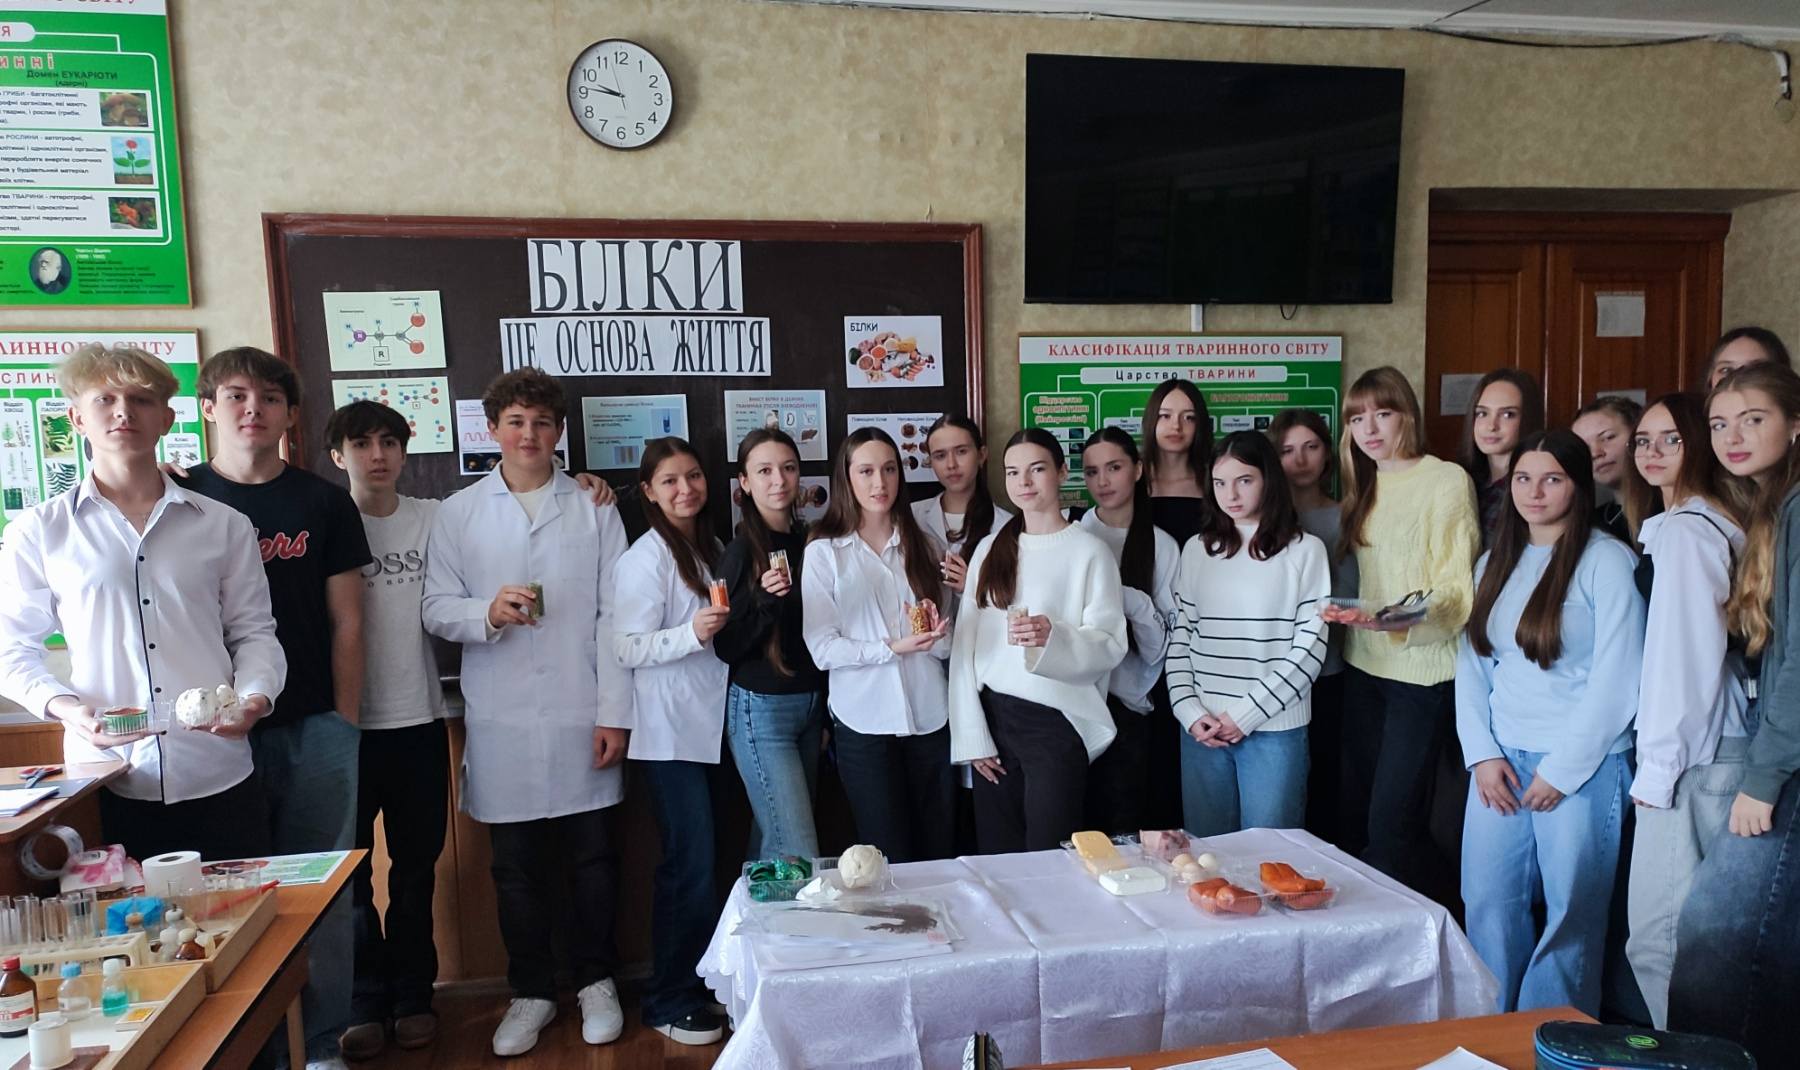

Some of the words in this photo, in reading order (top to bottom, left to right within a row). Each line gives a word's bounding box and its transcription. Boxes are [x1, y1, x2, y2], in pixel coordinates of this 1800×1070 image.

[596, 55, 608, 70] 11
[614, 51, 629, 65] 12
[638, 59, 643, 73] 1
[582, 68, 597, 82] 10
[648, 74, 659, 88] 2
[578, 86, 588, 99] 9
[653, 92, 663, 106] 3
[584, 105, 594, 119] 8
[647, 111, 658, 124] 4
[598, 118, 608, 132] 7
[634, 122, 645, 136] 5
[616, 126, 626, 140] 6
[531, 240, 738, 312] БІЛКИ
[850, 322, 878, 332] БІЛКИ
[556, 319, 655, 373] ОСНОВА
[671, 319, 766, 373] ЖИТТЯ
[1048, 343, 1171, 358] КЛАСИФІКАЦІЯ
[1176, 343, 1280, 356] ТВАРИННОГО
[1285, 342, 1329, 356] СВІТУ
[1115, 370, 1178, 382] Царство
[1188, 369, 1256, 380] ТВАРИНИ
[253, 528, 309, 562] ers
[361, 550, 423, 578] OSS
